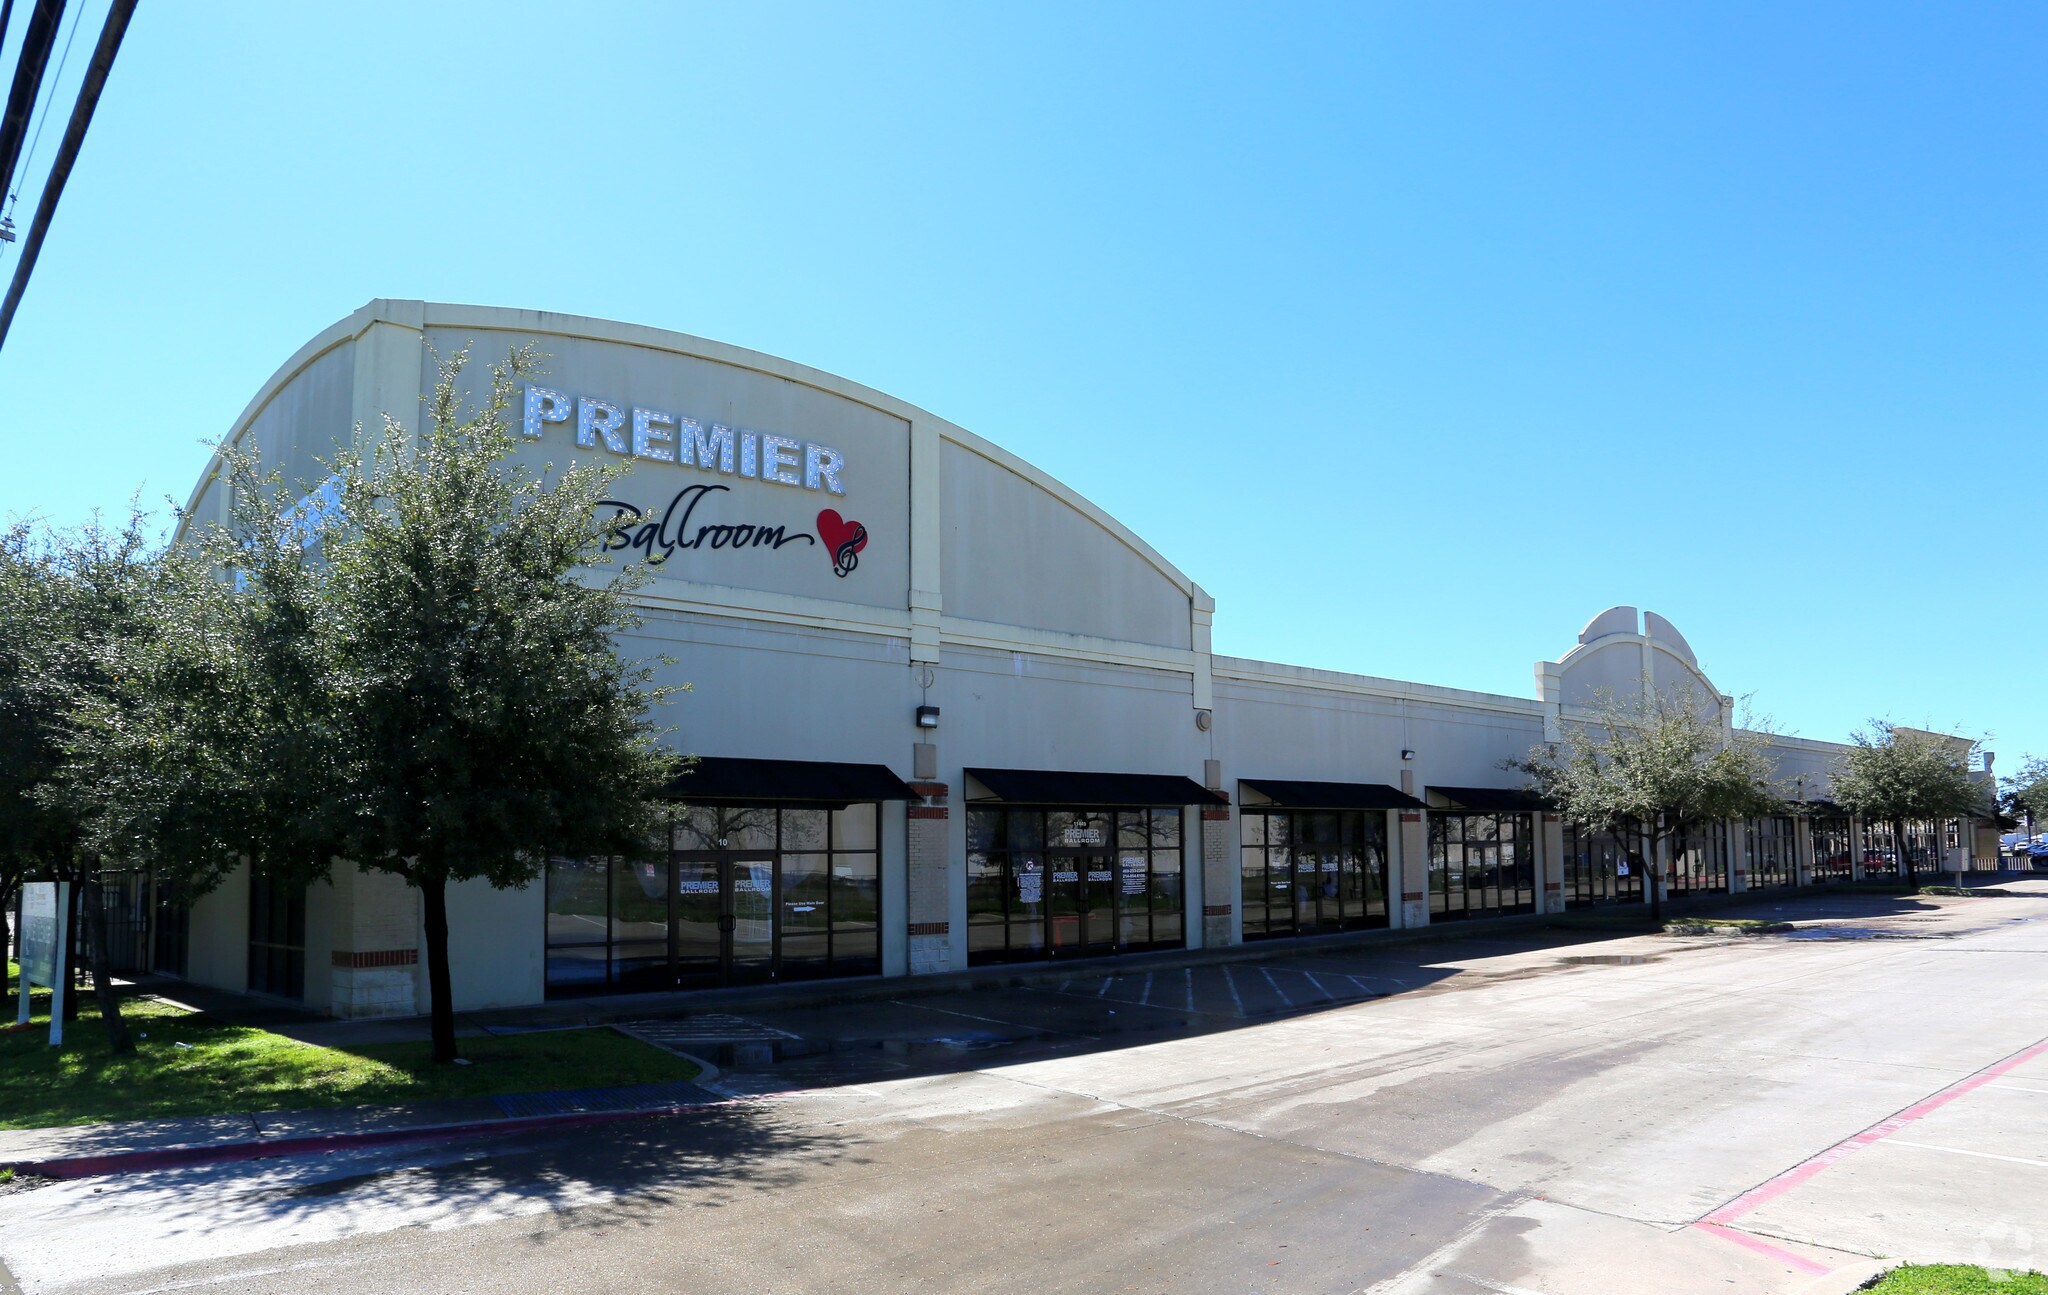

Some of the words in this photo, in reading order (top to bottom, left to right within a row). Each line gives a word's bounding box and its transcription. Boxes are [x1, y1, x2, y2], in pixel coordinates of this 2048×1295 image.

[523, 384, 846, 496] PREMIER
[597, 484, 815, 565] Ballroom
[1064, 829, 1099, 838] PREMIER
[1053, 871, 1078, 879] PREMIER
[680, 881, 719, 889] PREMIER
[735, 879, 770, 888] PREMIER
